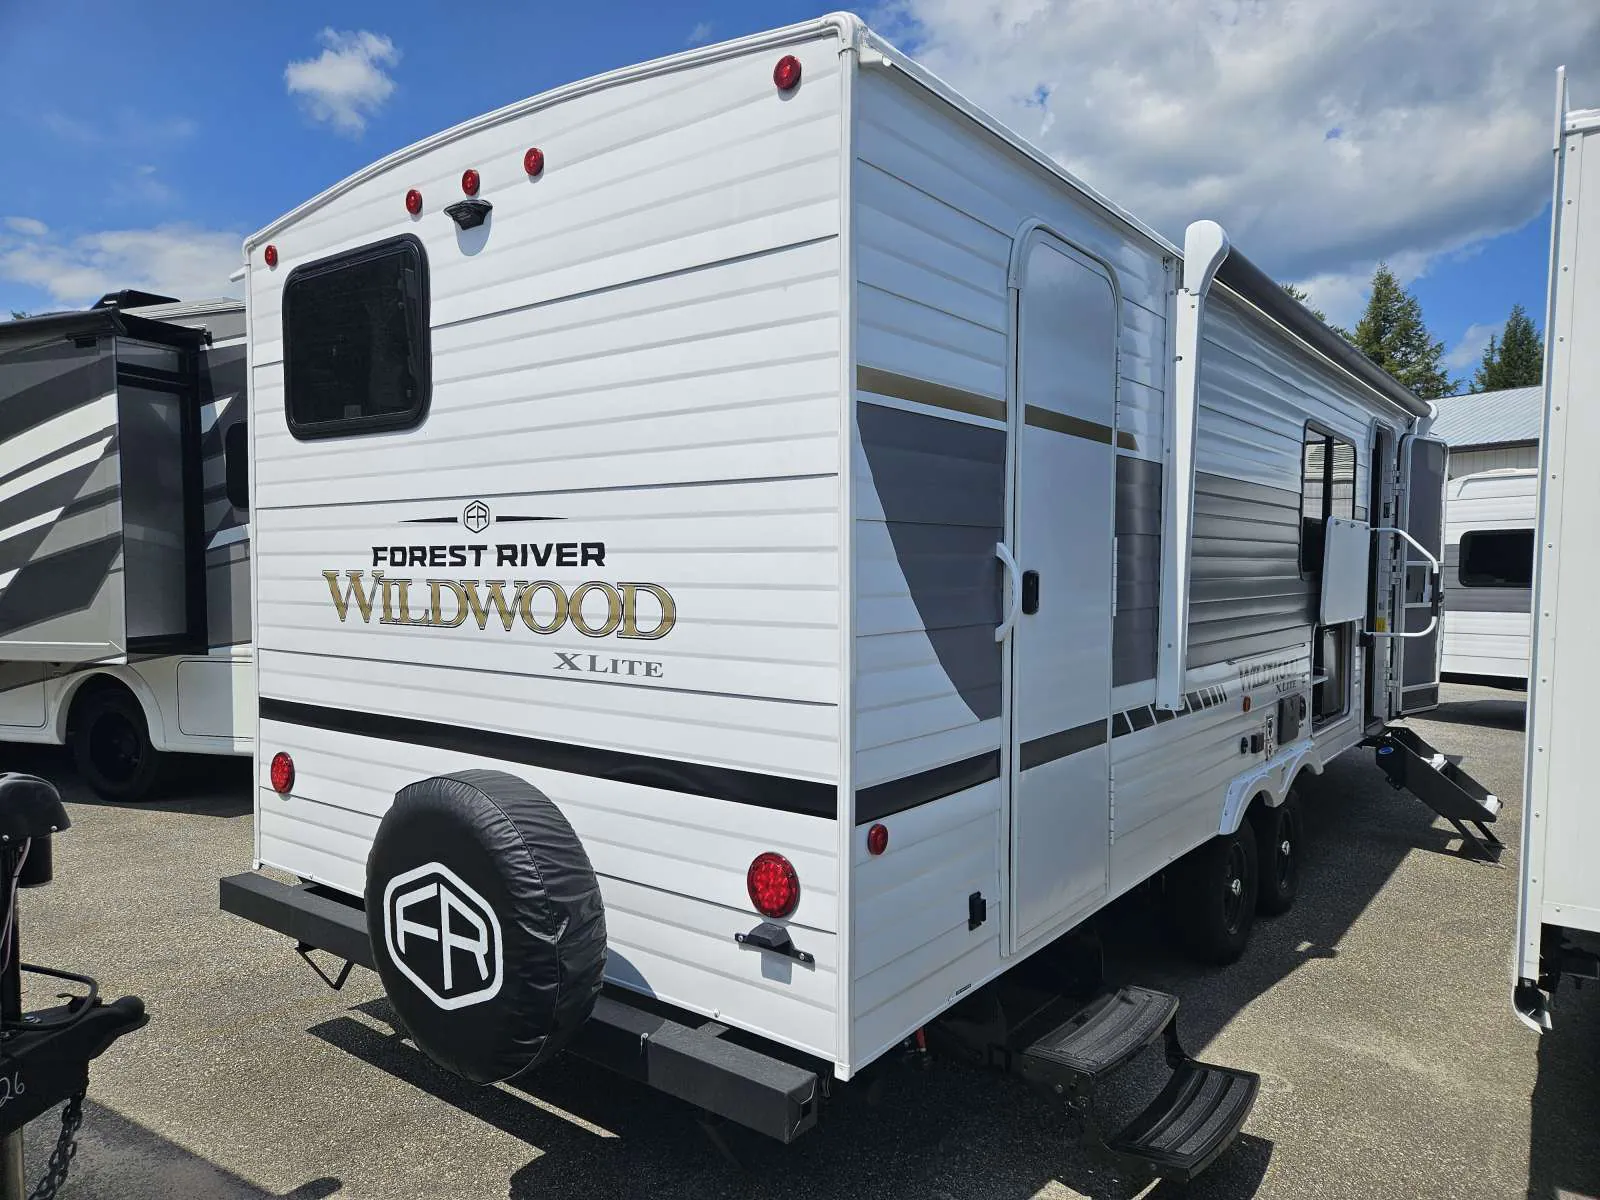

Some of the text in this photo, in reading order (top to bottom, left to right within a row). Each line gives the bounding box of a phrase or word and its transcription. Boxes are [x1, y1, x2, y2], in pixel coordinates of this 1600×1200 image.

[372, 542, 606, 567] FOREST RIVER
[322, 569, 677, 641] WILDWOOD
